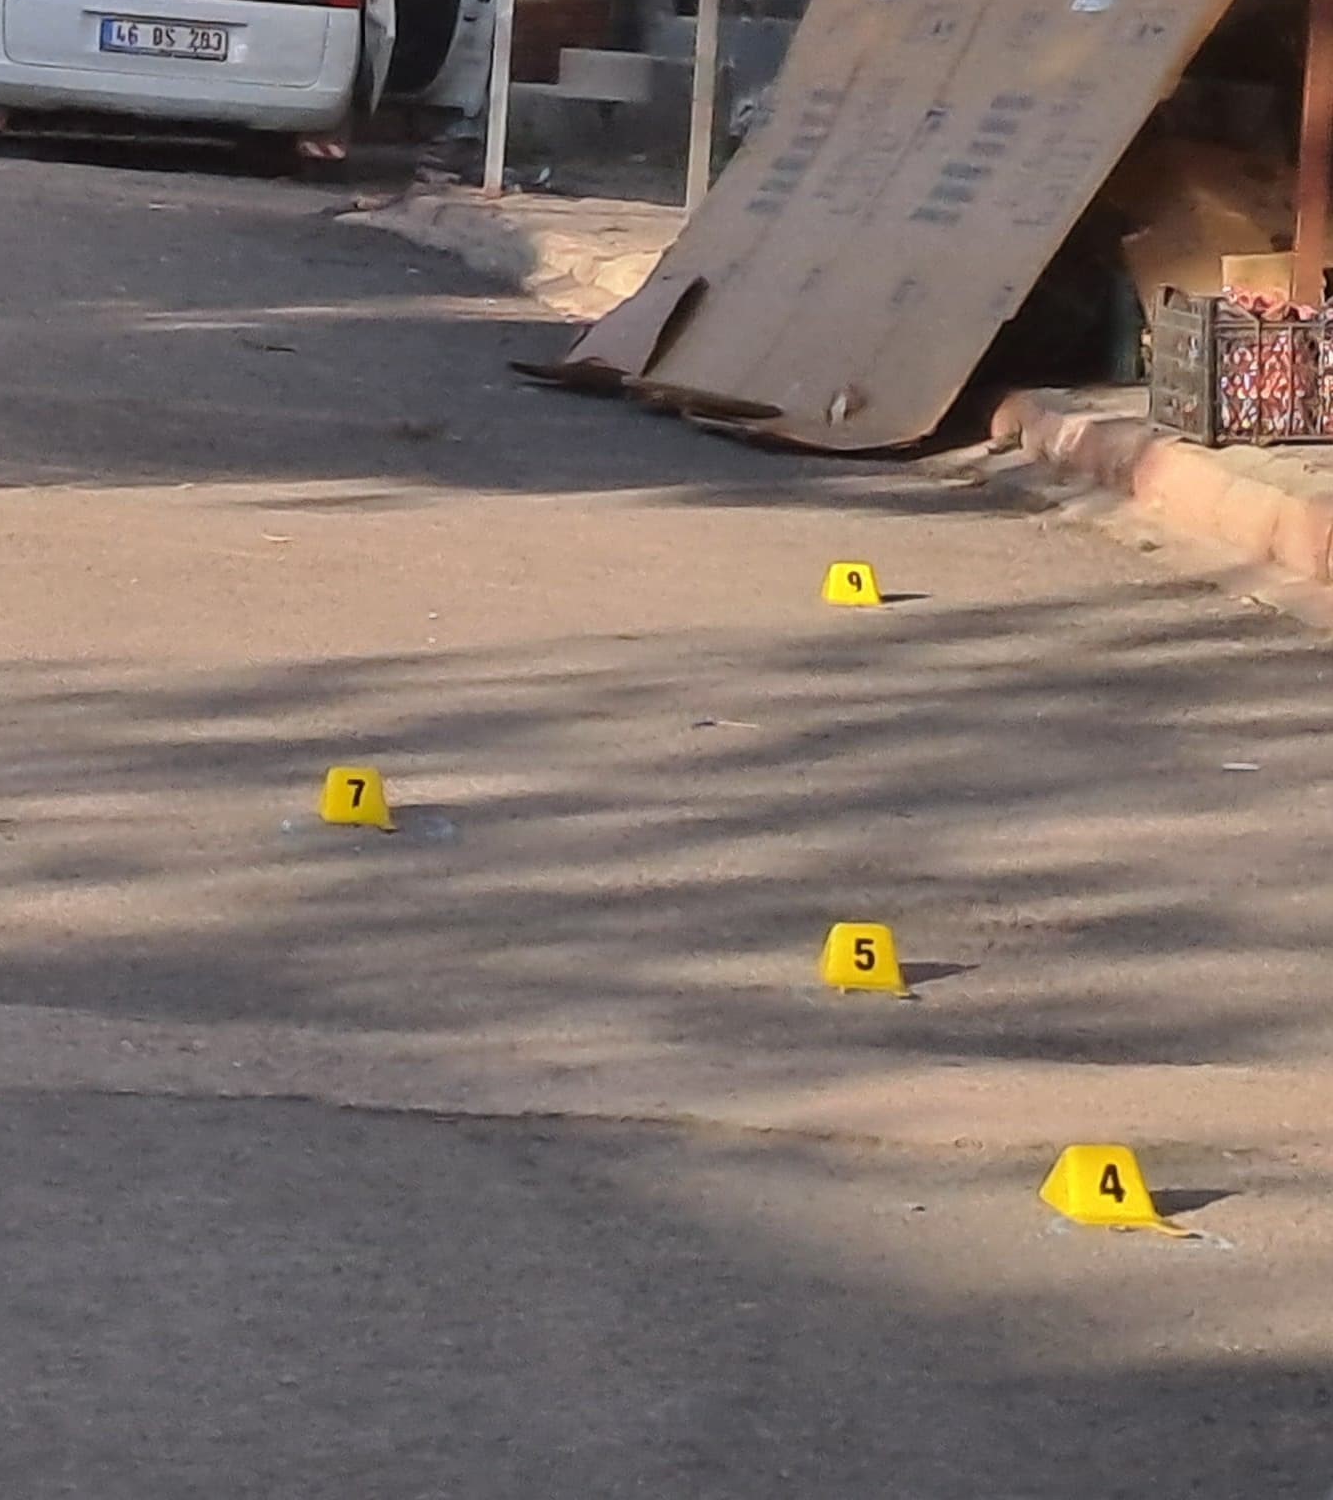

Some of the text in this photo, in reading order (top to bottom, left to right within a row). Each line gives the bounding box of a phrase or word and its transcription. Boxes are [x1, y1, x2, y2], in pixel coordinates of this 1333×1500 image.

[846, 571, 863, 593] 9
[346, 778, 366, 809] 7
[853, 938, 876, 972] 5
[1099, 1163, 1127, 1203] 4
